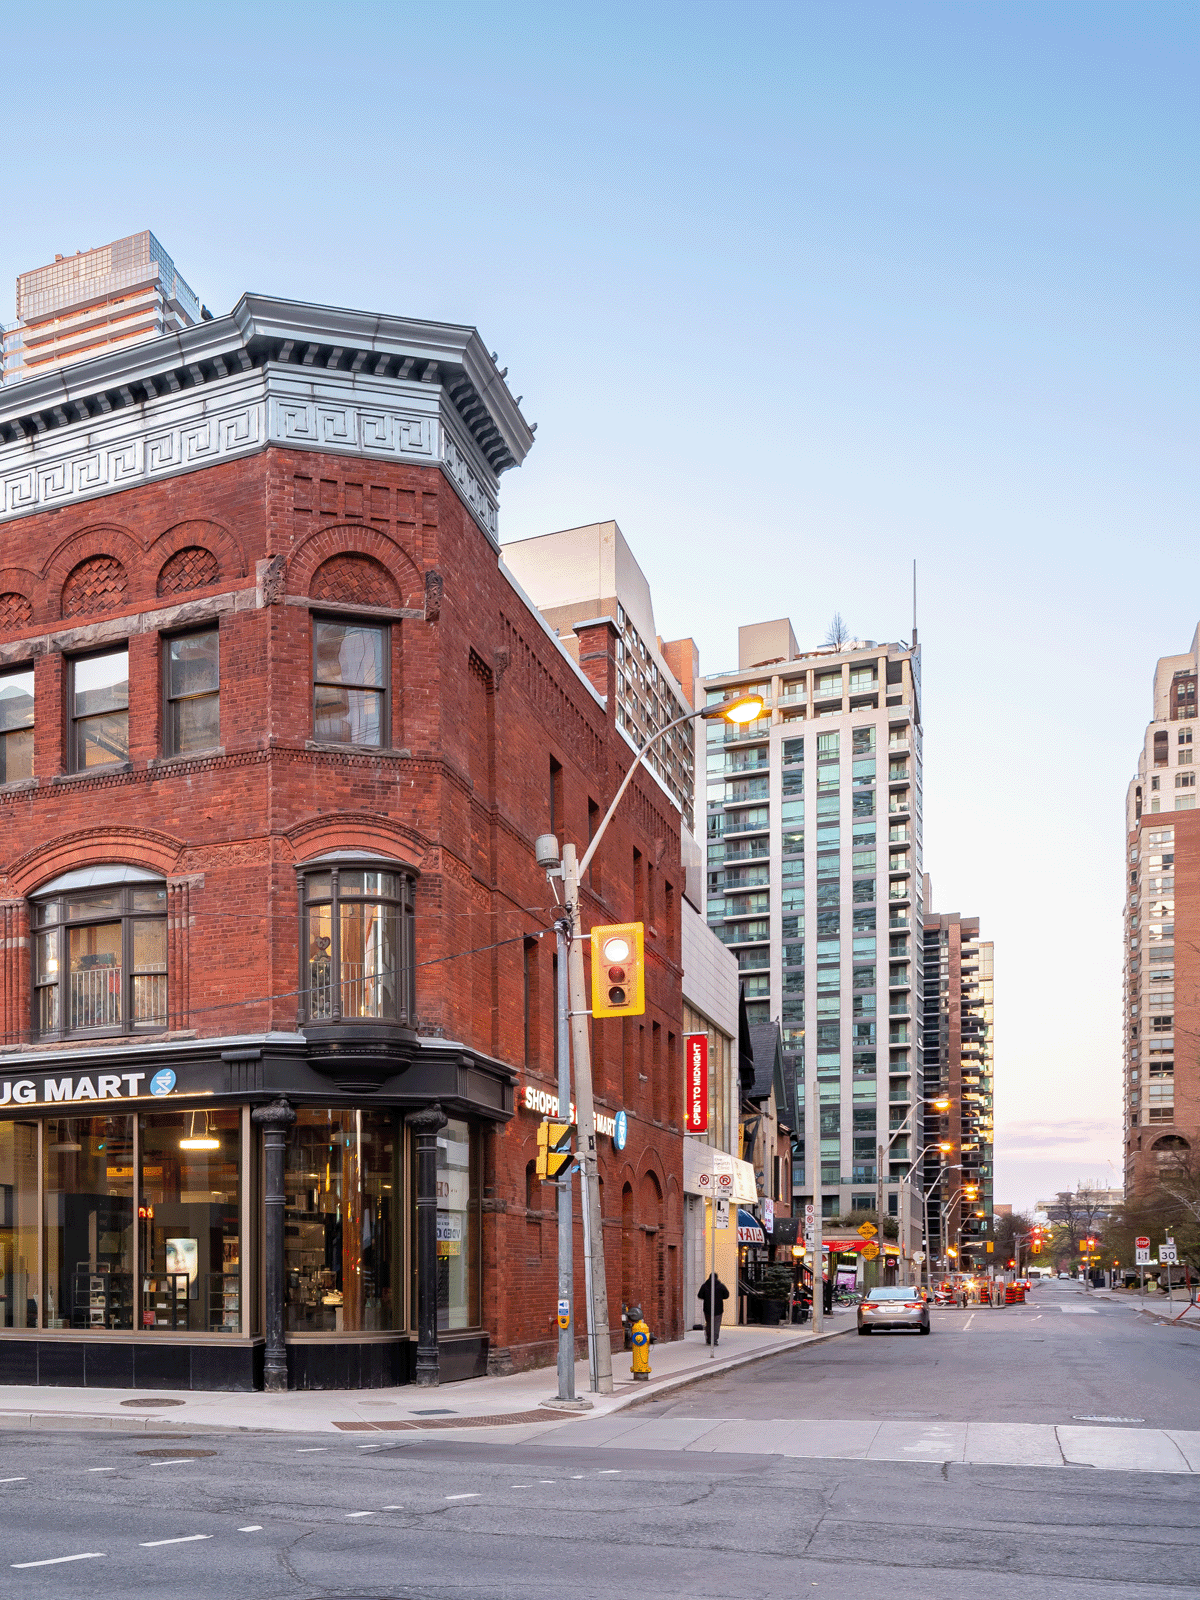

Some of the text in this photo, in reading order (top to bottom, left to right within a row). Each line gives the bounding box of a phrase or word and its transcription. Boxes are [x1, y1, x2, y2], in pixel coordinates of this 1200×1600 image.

[44, 1073, 145, 1102] MART
[693, 1042, 701, 1126] OPEN TO MIDNIGHT
[525, 1086, 574, 1122] SHOPPS
[597, 1113, 616, 1137] MART
[1161, 1251, 1176, 1260] 30
